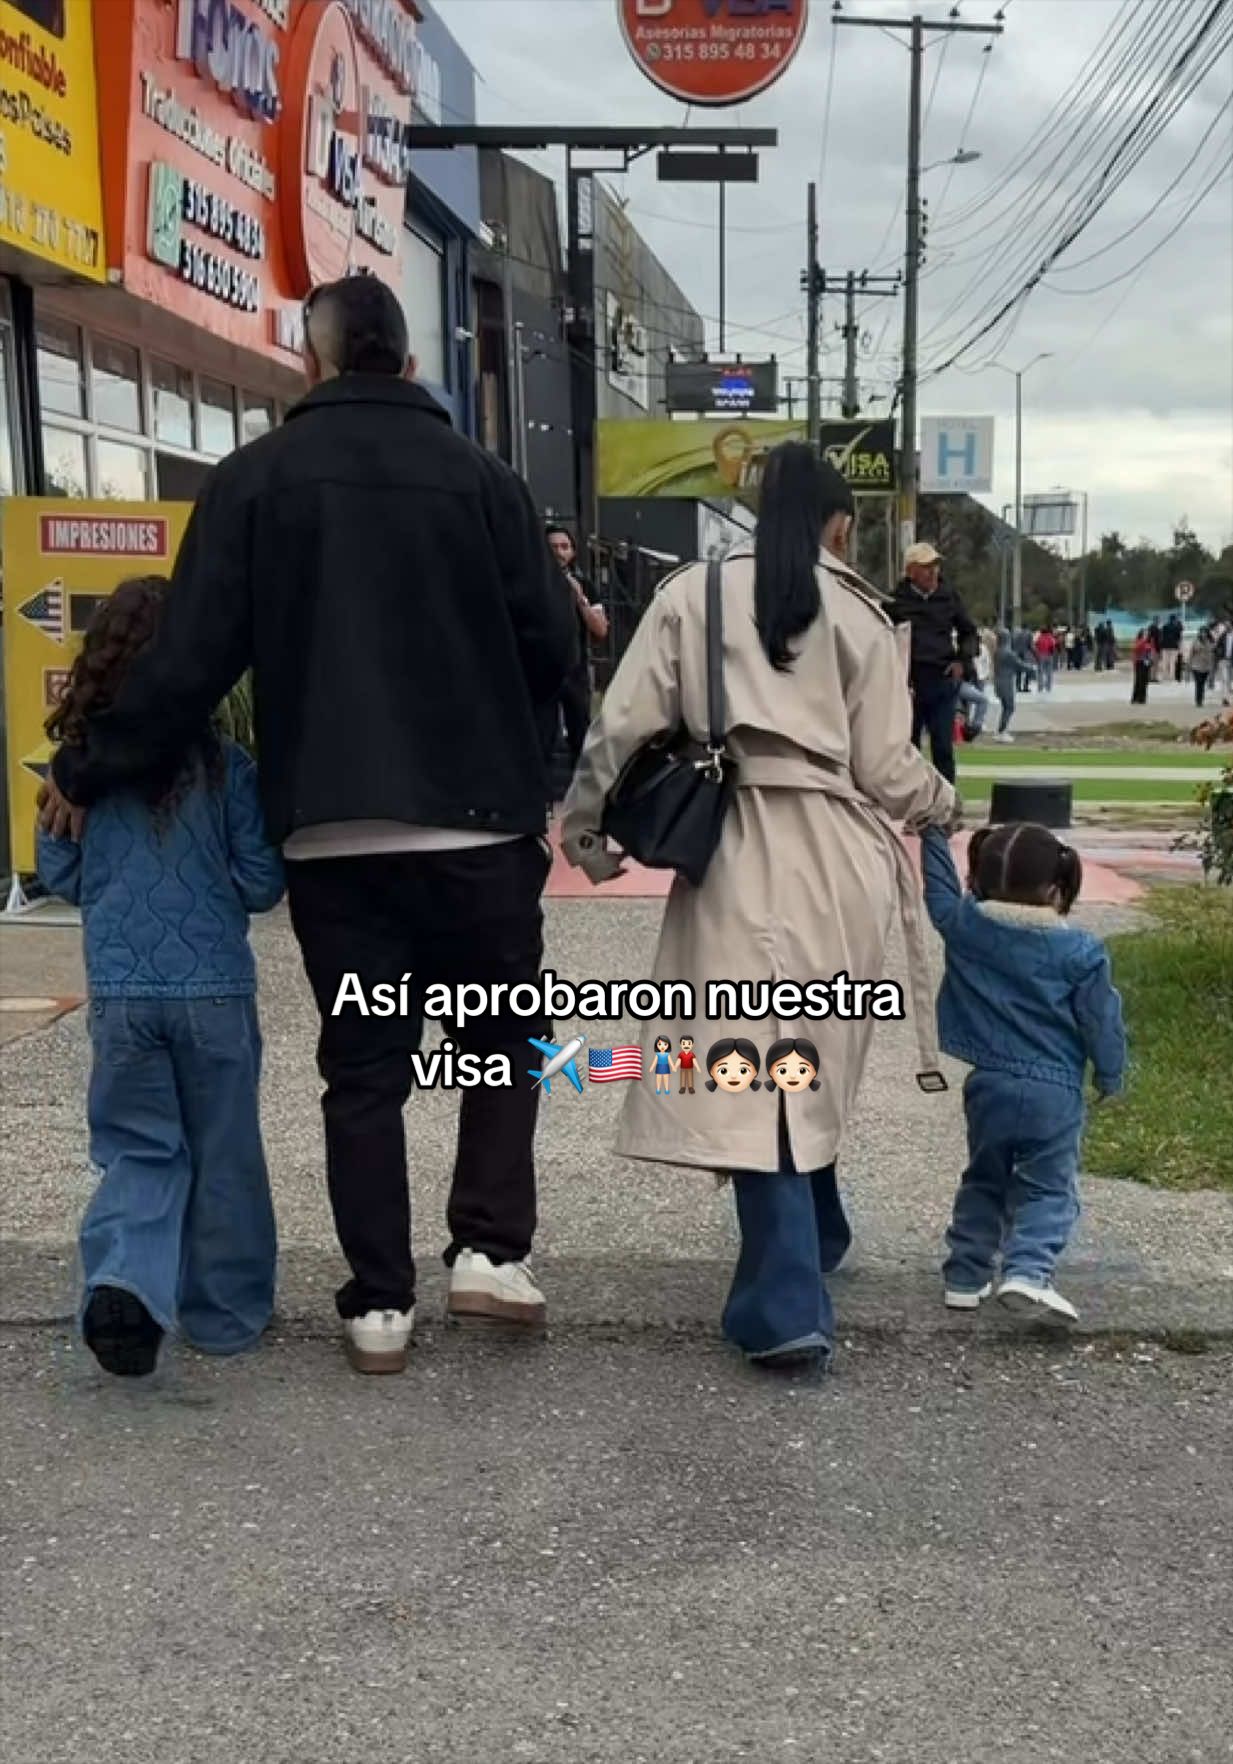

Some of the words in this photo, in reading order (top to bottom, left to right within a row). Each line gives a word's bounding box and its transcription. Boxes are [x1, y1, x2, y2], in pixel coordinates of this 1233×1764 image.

[664, 43, 694, 60] 315
[700, 43, 730, 60] 895
[735, 43, 756, 60] 48
[762, 43, 781, 60] 34
[48, 519, 159, 552] IMPRESIONES
